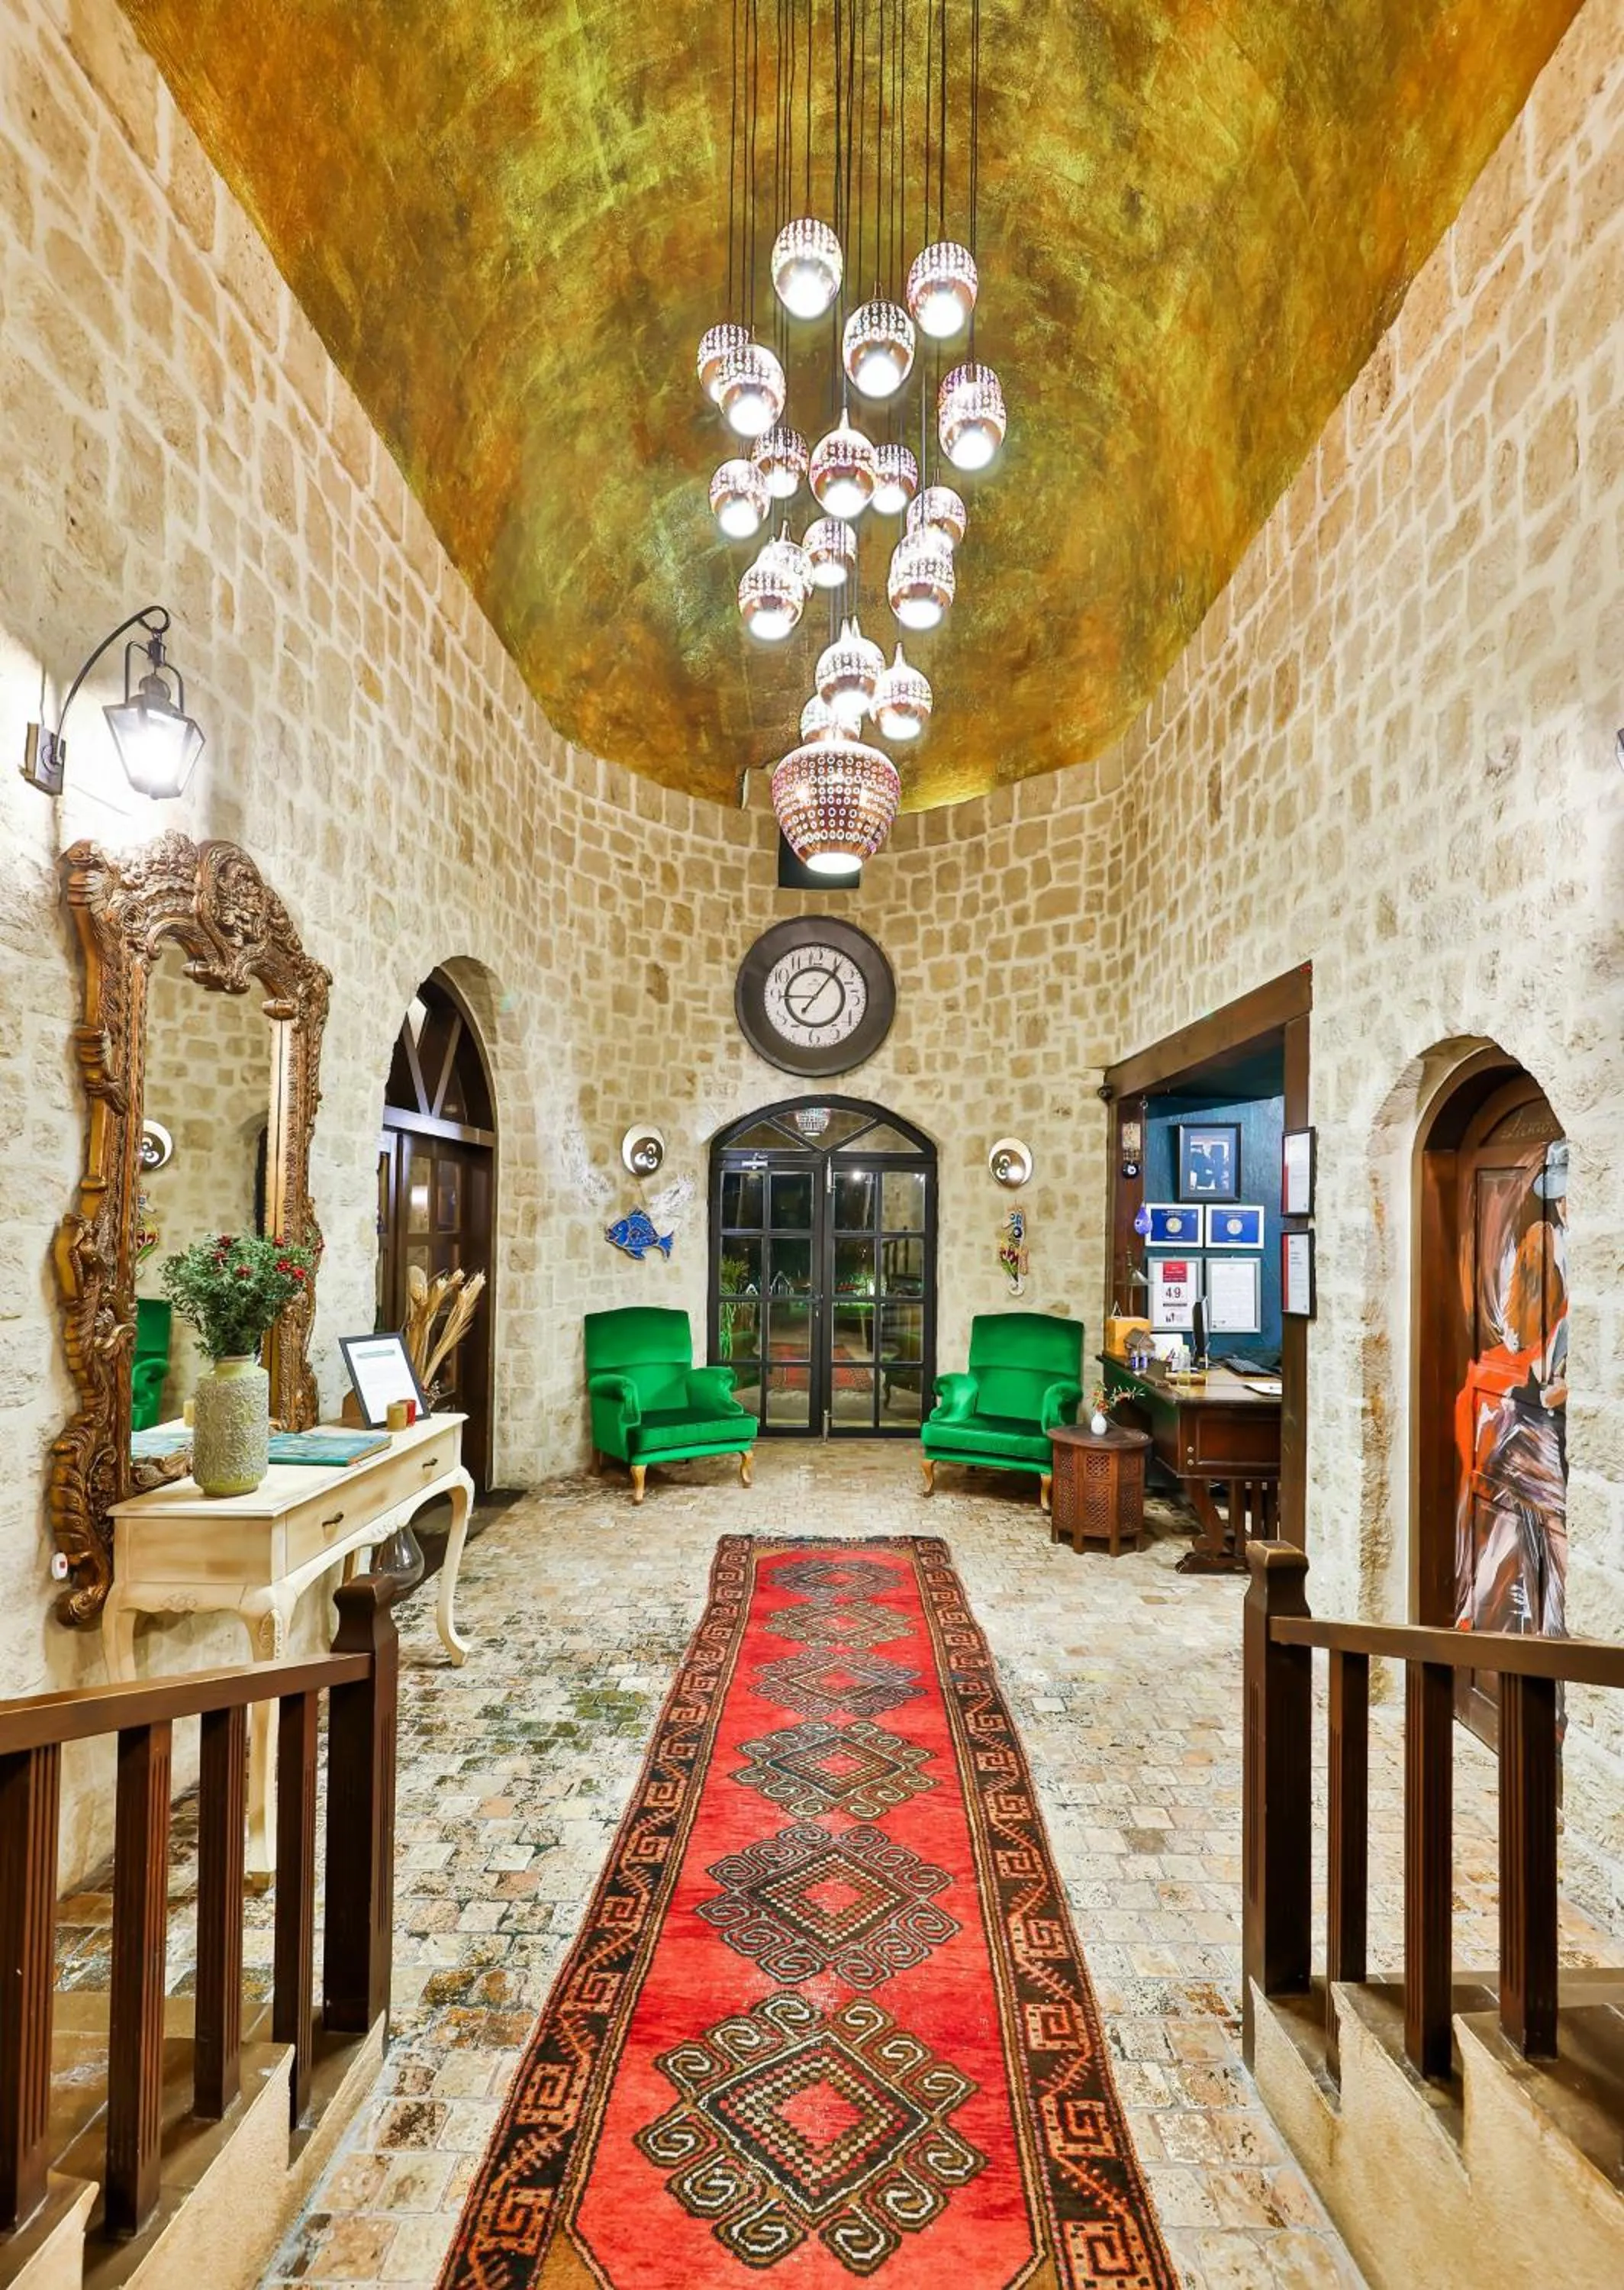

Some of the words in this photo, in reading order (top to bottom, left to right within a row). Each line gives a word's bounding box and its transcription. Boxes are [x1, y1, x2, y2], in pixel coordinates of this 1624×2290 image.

[792, 956, 801, 969] 11
[809, 950, 823, 965] 12
[775, 968, 789, 984] 10
[843, 969, 854, 985] 2
[770, 989, 781, 1003] 9
[808, 1028, 820, 1043] 6
